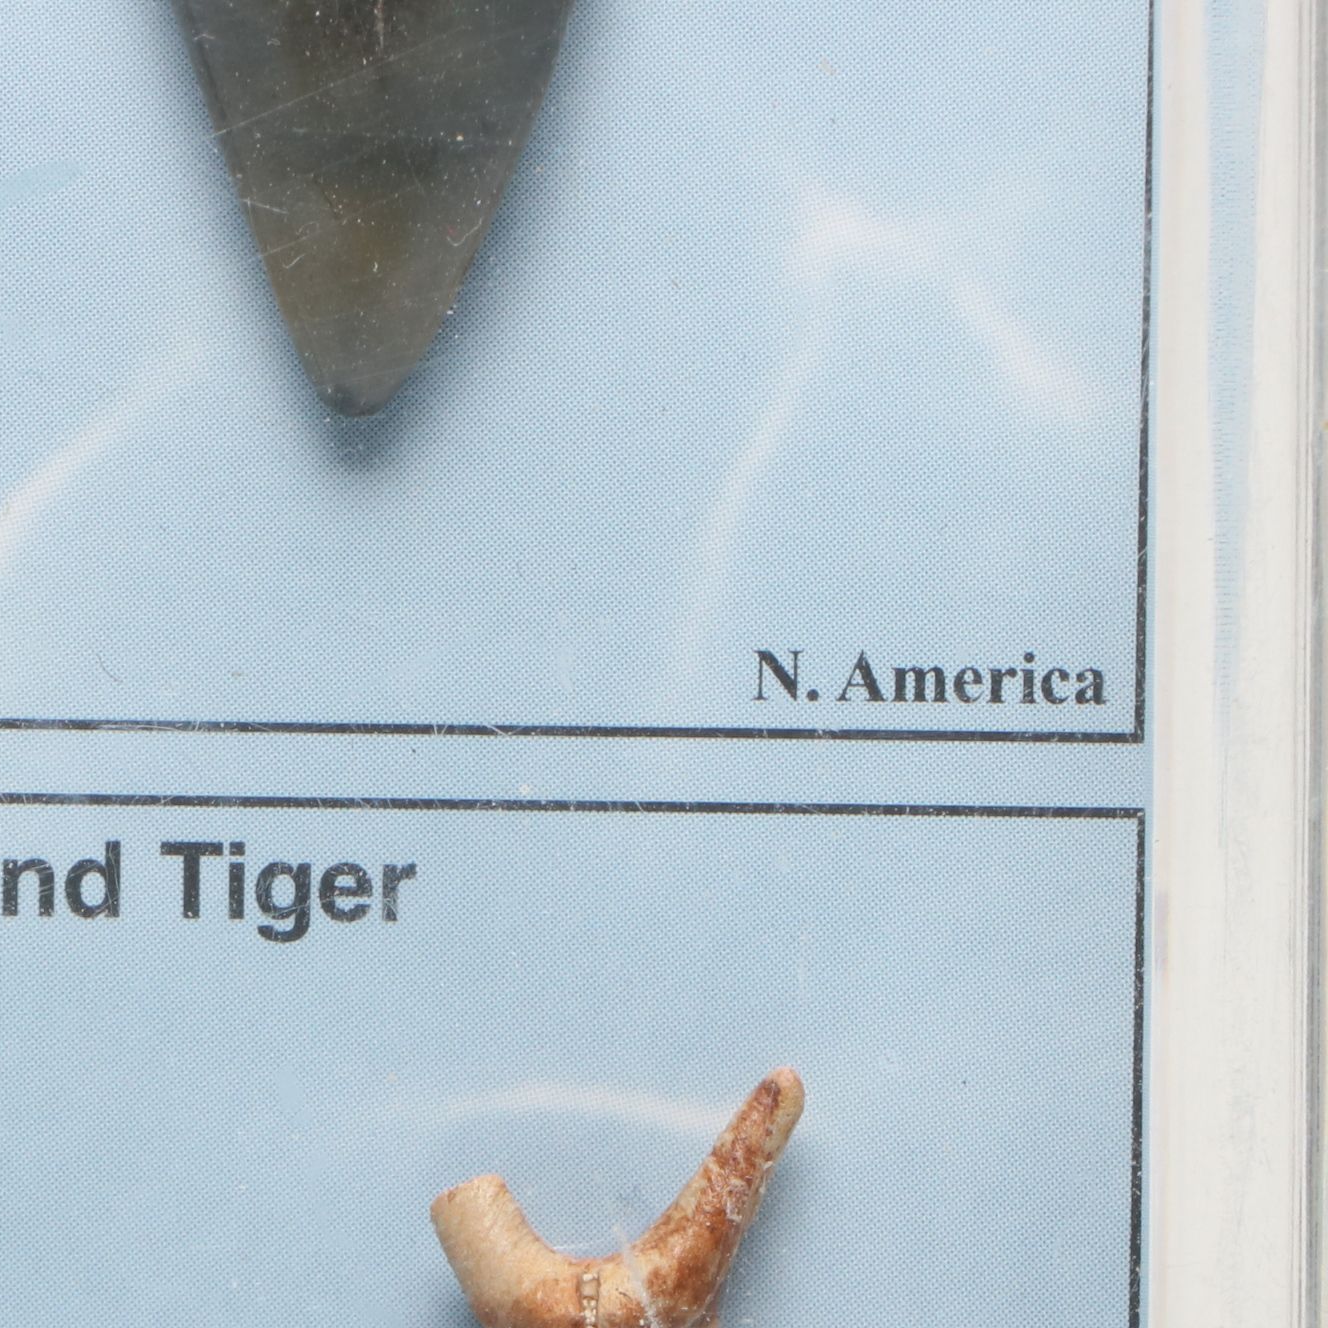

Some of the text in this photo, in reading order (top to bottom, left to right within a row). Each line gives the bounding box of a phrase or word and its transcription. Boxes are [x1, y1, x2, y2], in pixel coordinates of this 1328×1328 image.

[752, 648, 1107, 706] N. America
[160, 839, 418, 943] Tiger
